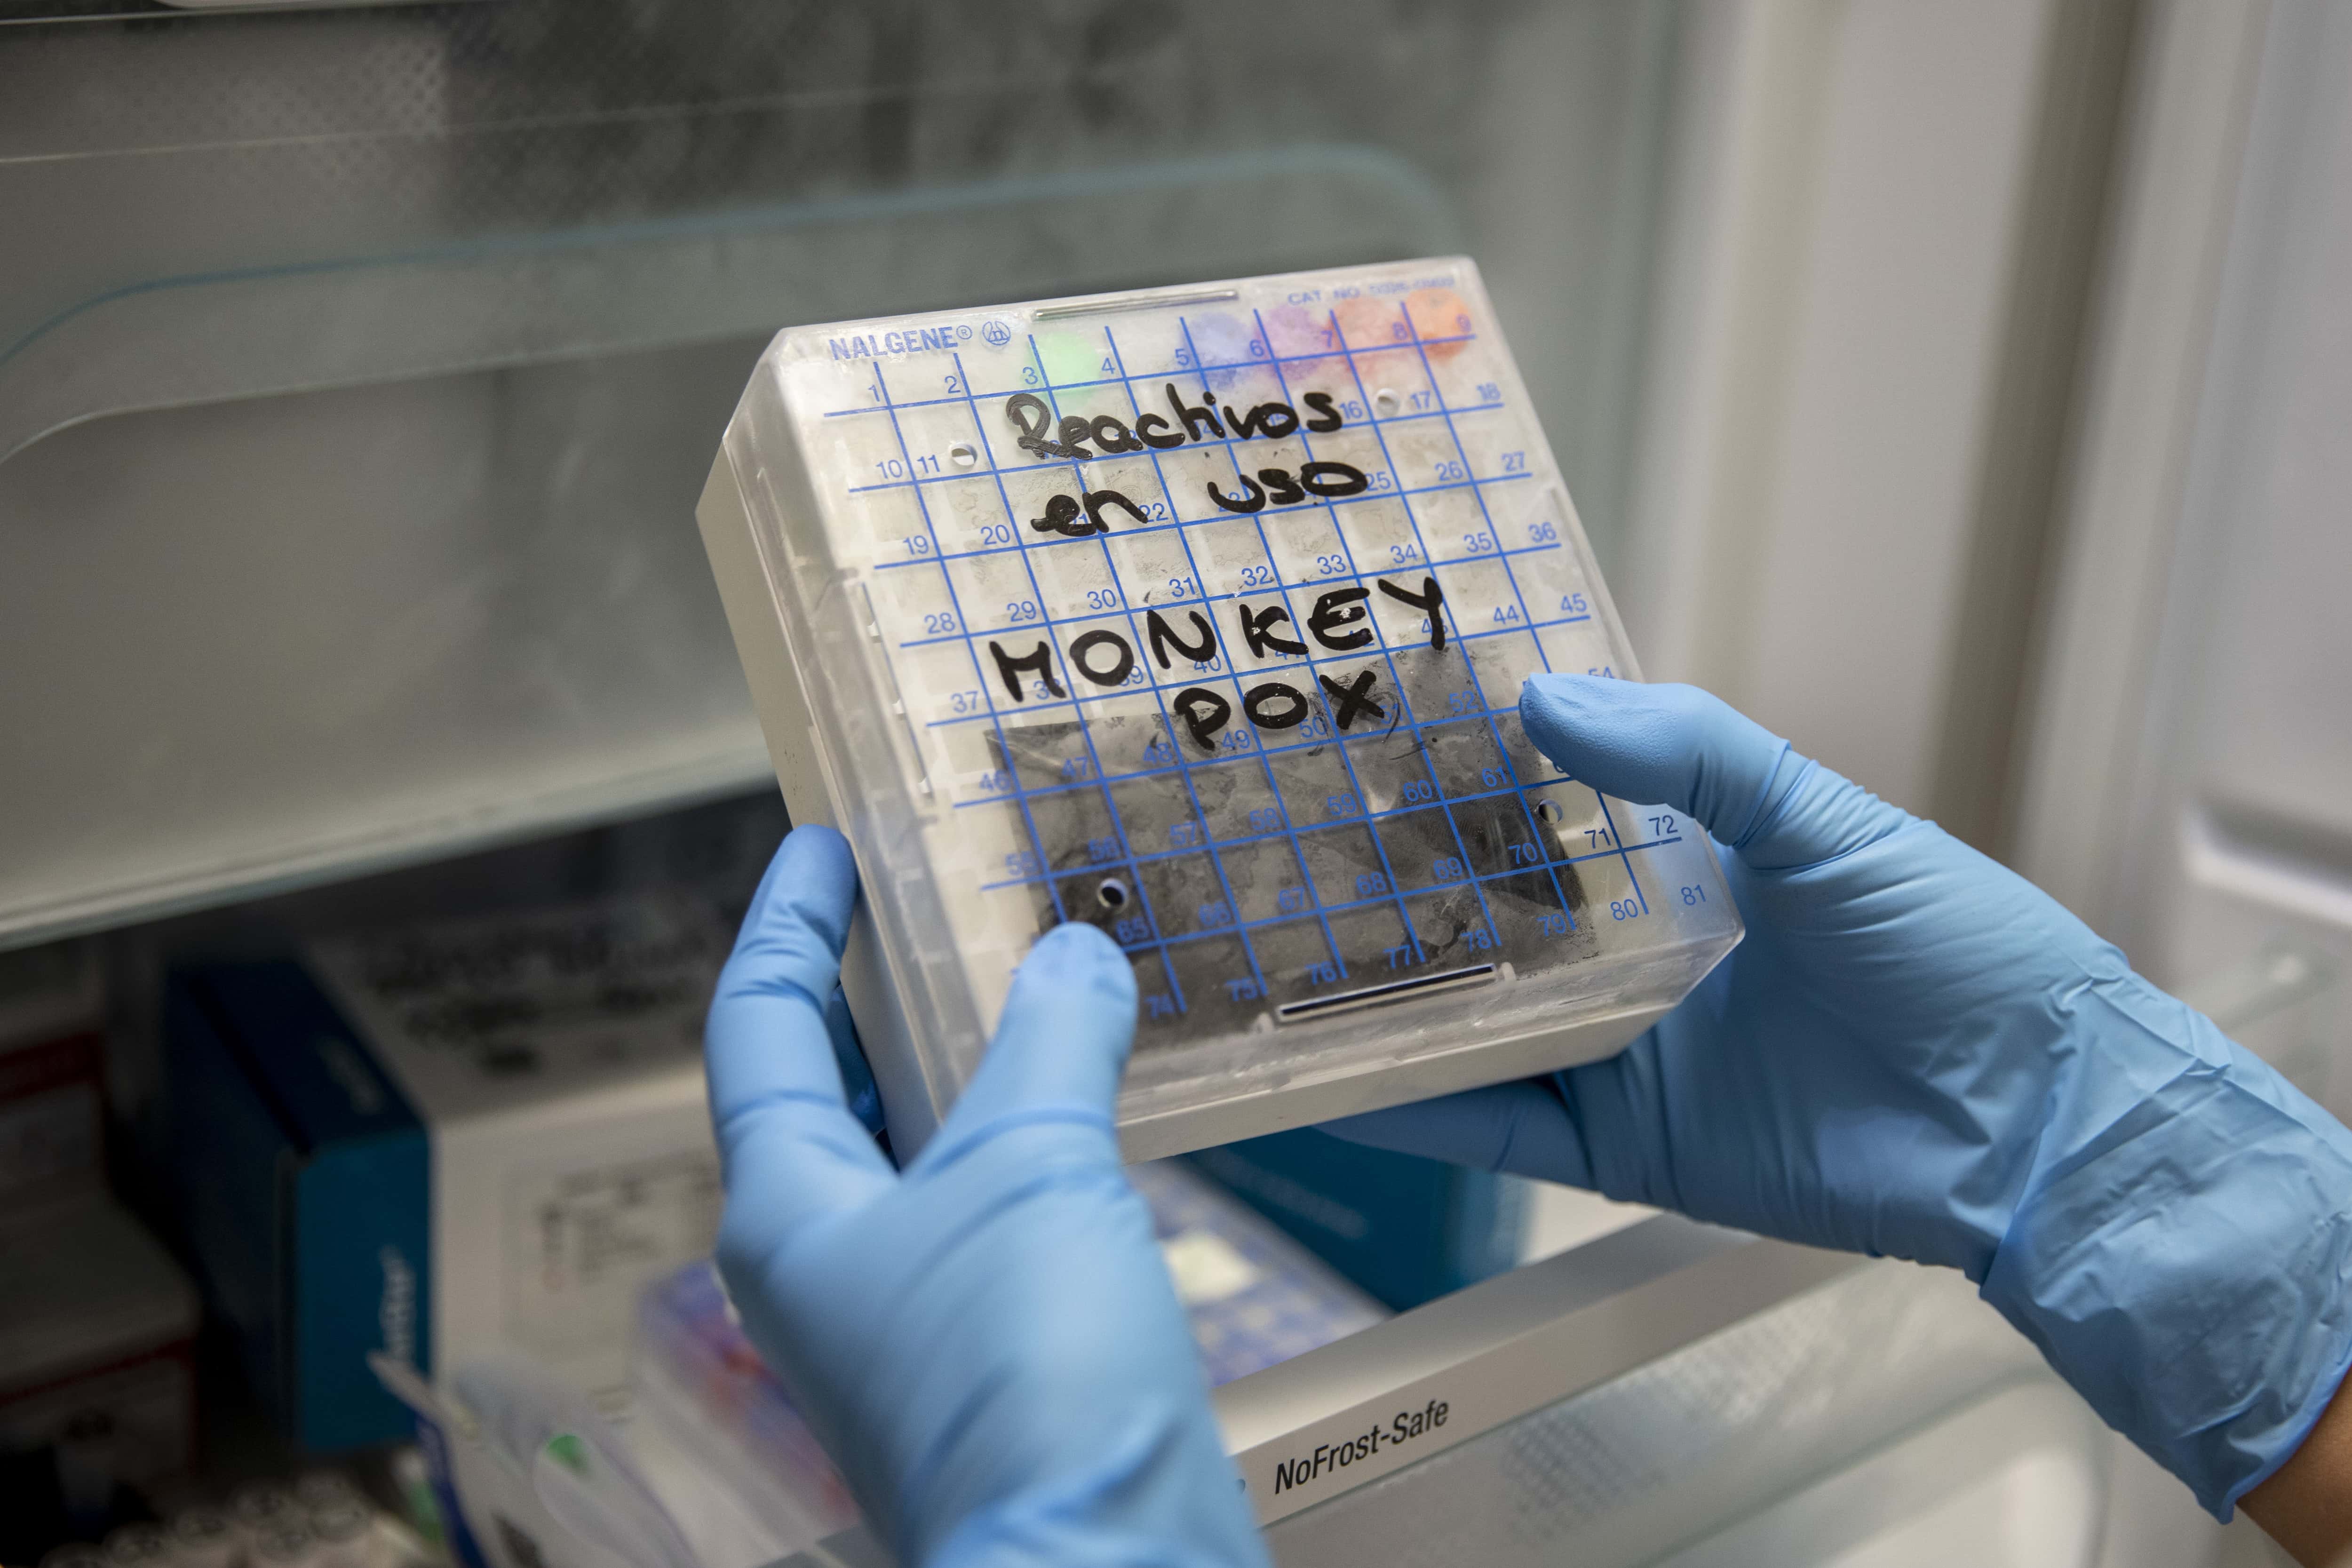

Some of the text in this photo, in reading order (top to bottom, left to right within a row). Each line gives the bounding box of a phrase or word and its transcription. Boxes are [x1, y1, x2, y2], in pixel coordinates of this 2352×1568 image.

[868, 314, 1471, 402] 1 2 3 4 5 6 7 8 9
[876, 459, 903, 479] 10
[916, 454, 940, 474] 11
[1339, 400, 1363, 419] 16
[1410, 391, 1431, 410] 17
[1477, 383, 1501, 402] 18
[903, 535, 929, 556] 19
[980, 524, 1010, 546] 20
[1138, 503, 1168, 523] 22
[1366, 472, 1391, 491] 25
[1435, 462, 1462, 481] 26
[1502, 452, 1526, 472] 27
[1031, 490, 1148, 537] en
[1207, 462, 1368, 513] uso
[924, 522, 1557, 635] 28 29 30 31 32 33 34 35 36
[950, 690, 978, 713] 37
[1194, 654, 1221, 673] 40
[1493, 605, 1520, 625] 44
[1560, 593, 1587, 613] 45
[978, 769, 1010, 793] 46
[1062, 756, 1089, 778] 47
[1143, 743, 1173, 764] 48
[1223, 729, 1250, 750] 49
[1298, 717, 1327, 738] 50
[1449, 691, 1478, 712] 52
[1174, 670, 1384, 751] POX
[1170, 822, 1197, 845] 57
[1249, 808, 1279, 830] 58
[1327, 793, 1356, 816] 59
[1404, 780, 1432, 802] 60
[1482, 766, 1508, 787] 61
[1279, 887, 1306, 910] 67
[1356, 872, 1386, 894] 68
[1433, 857, 1463, 879] 69
[1508, 843, 1537, 864] 70
[1585, 828, 1611, 849] 71
[1649, 815, 1678, 836] 72
[1225, 977, 1257, 1002] 75
[1305, 962, 1336, 985] 76
[1383, 944, 1411, 969] 77
[1461, 928, 1491, 952] 78
[1536, 914, 1565, 936] 79
[1610, 899, 1638, 921] 80
[1681, 884, 1706, 906] 81
[1275, 1398, 1449, 1495] NoFrost-Safe
